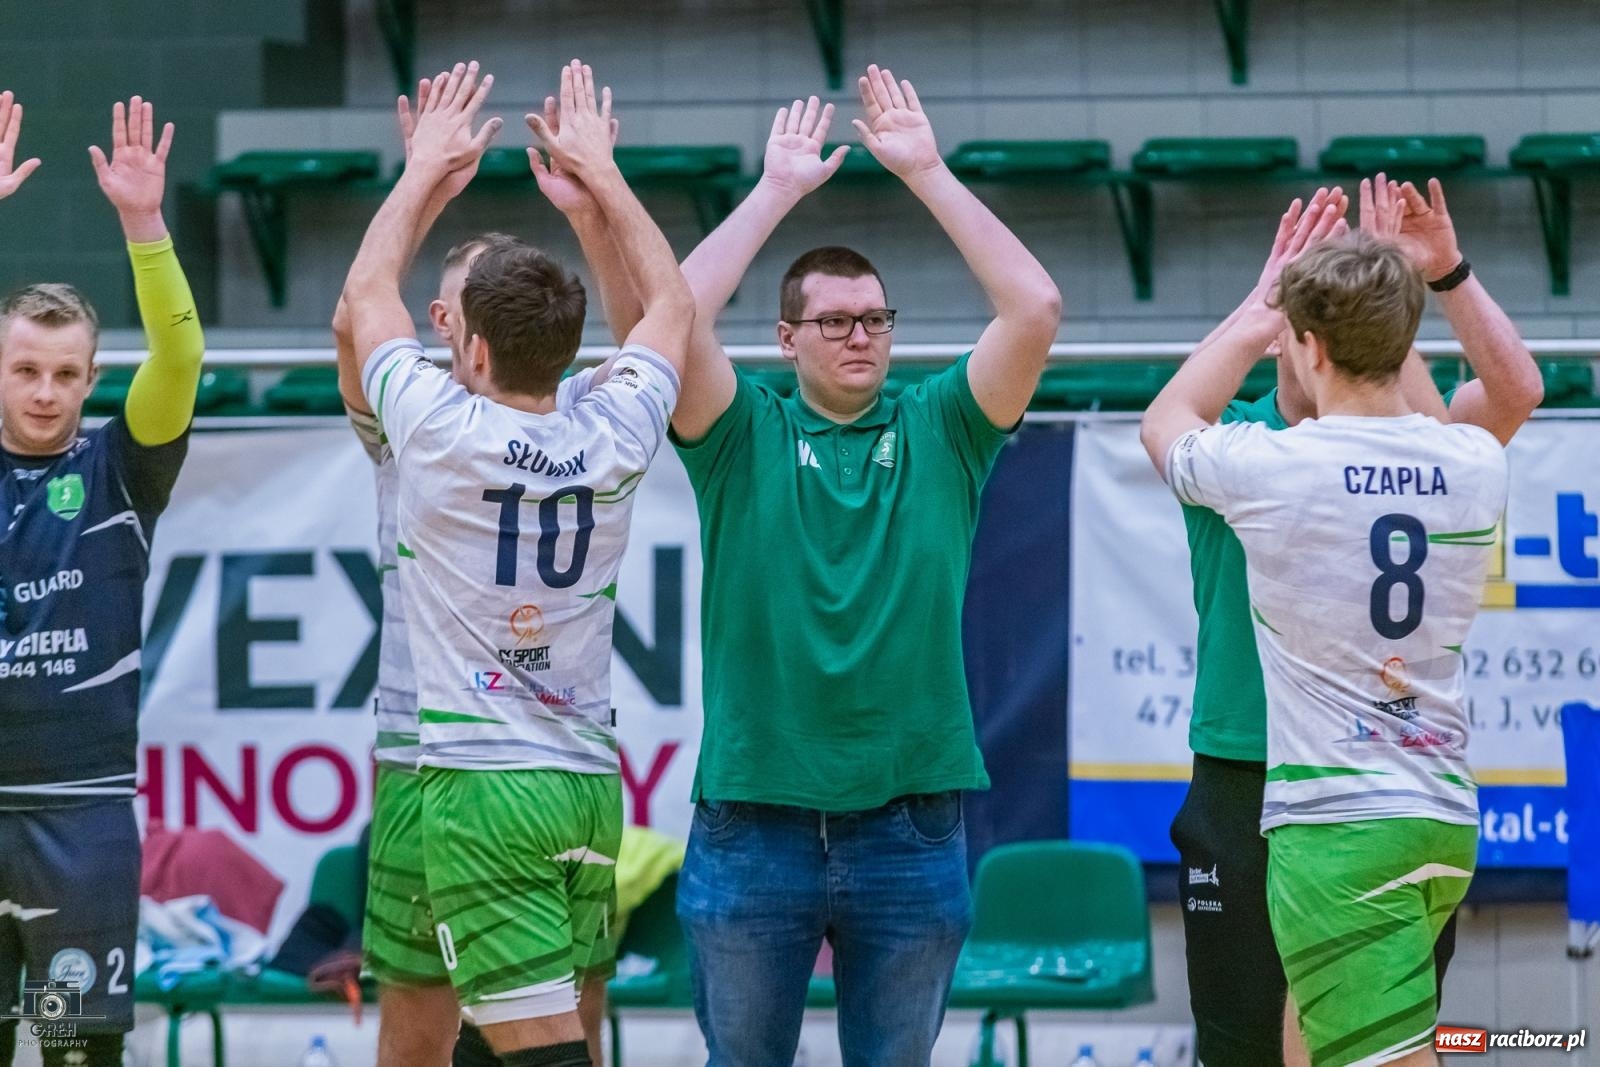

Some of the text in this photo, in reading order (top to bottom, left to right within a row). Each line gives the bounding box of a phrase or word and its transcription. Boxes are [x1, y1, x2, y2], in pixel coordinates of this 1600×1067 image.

[1344, 465, 1448, 495] CZAPLA
[482, 482, 595, 589] 10
[13, 568, 84, 603] GUARD
[1370, 513, 1428, 640] 8
[42, 658, 76, 676] 146
[514, 645, 550, 662] SPORT
[1503, 647, 1563, 681] 632
[107, 947, 128, 995] 2
